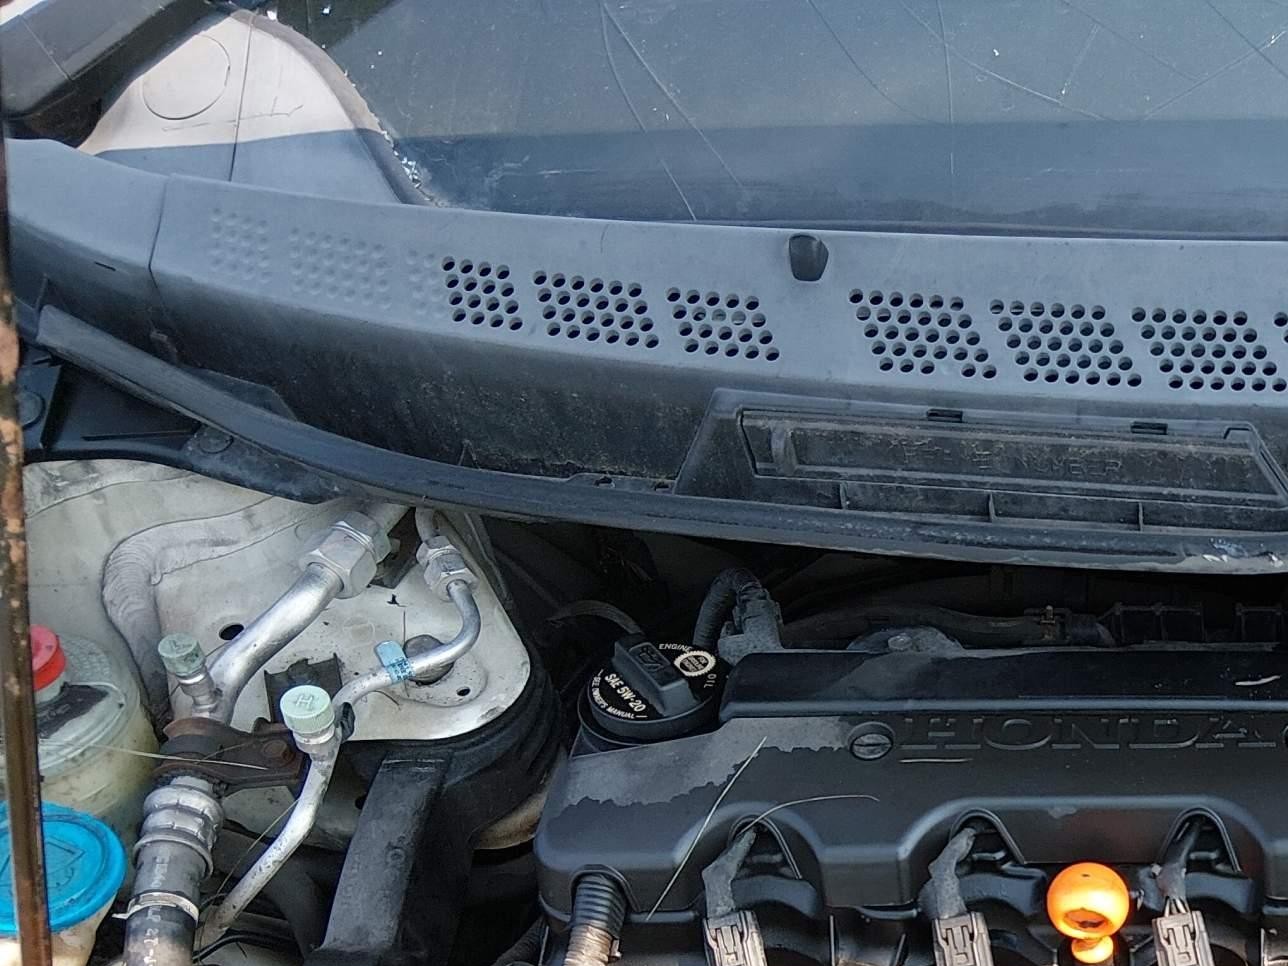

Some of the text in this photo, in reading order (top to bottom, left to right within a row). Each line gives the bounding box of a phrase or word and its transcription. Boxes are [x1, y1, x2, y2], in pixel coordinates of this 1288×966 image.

[604, 673, 647, 712] SAE 5W-20
[703, 673, 718, 689] OIL
[605, 705, 636, 719] MANUAL
[899, 717, 1277, 750] HONDA
